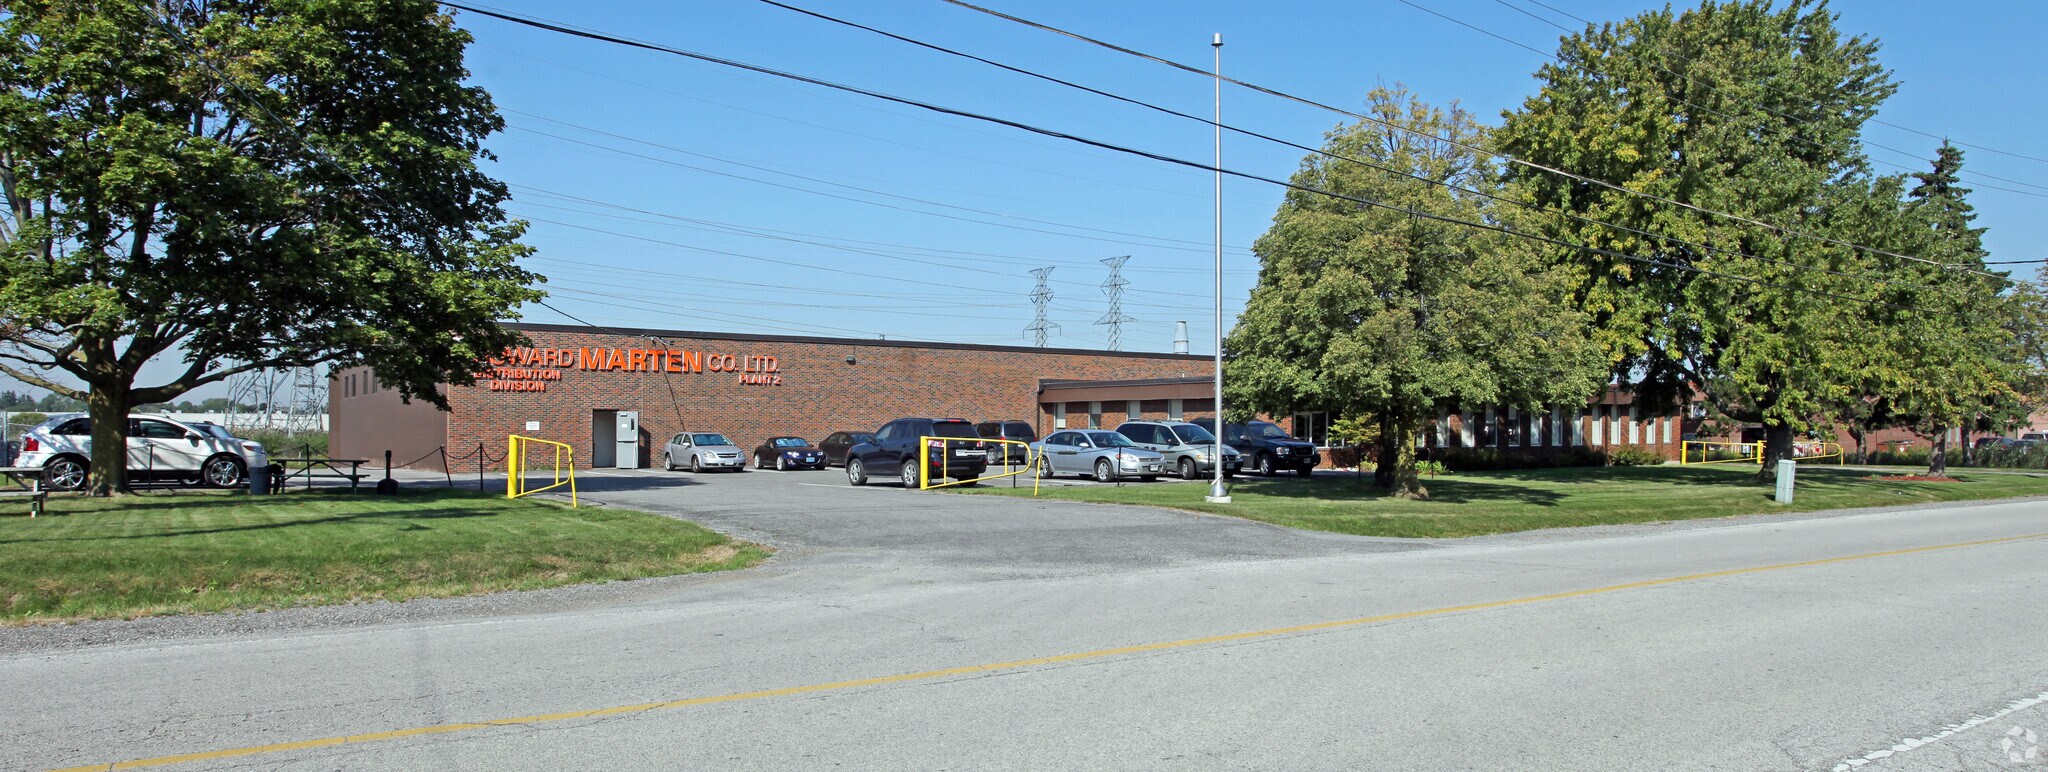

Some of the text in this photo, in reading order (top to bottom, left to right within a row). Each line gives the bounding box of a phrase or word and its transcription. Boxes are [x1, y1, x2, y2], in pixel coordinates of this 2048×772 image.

[473, 346, 781, 373] WARD MARTEN CO. LTD.
[490, 380, 545, 391] DIVISION
[739, 373, 782, 386] PLANT 2
